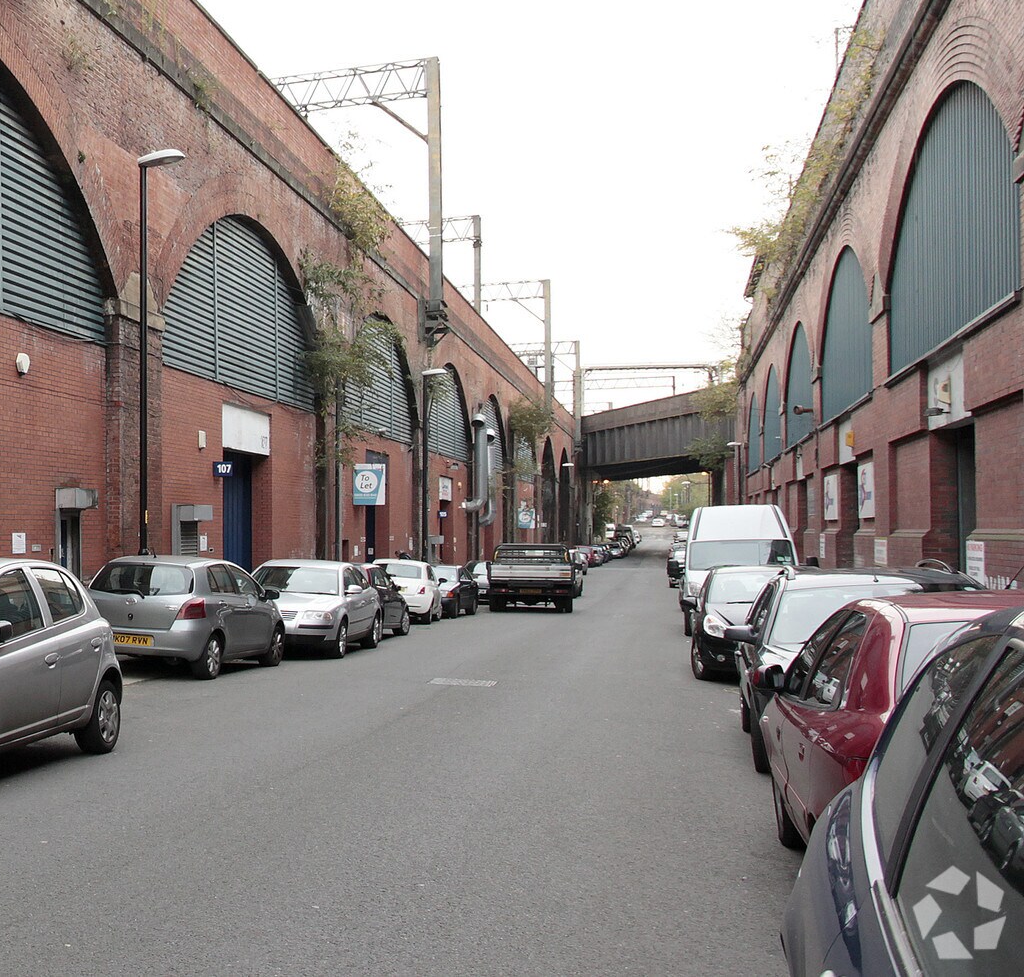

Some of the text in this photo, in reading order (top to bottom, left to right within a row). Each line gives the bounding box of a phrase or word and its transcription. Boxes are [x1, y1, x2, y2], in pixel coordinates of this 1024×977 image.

[216, 464, 231, 473] 107
[113, 634, 148, 645] K07 RVN
